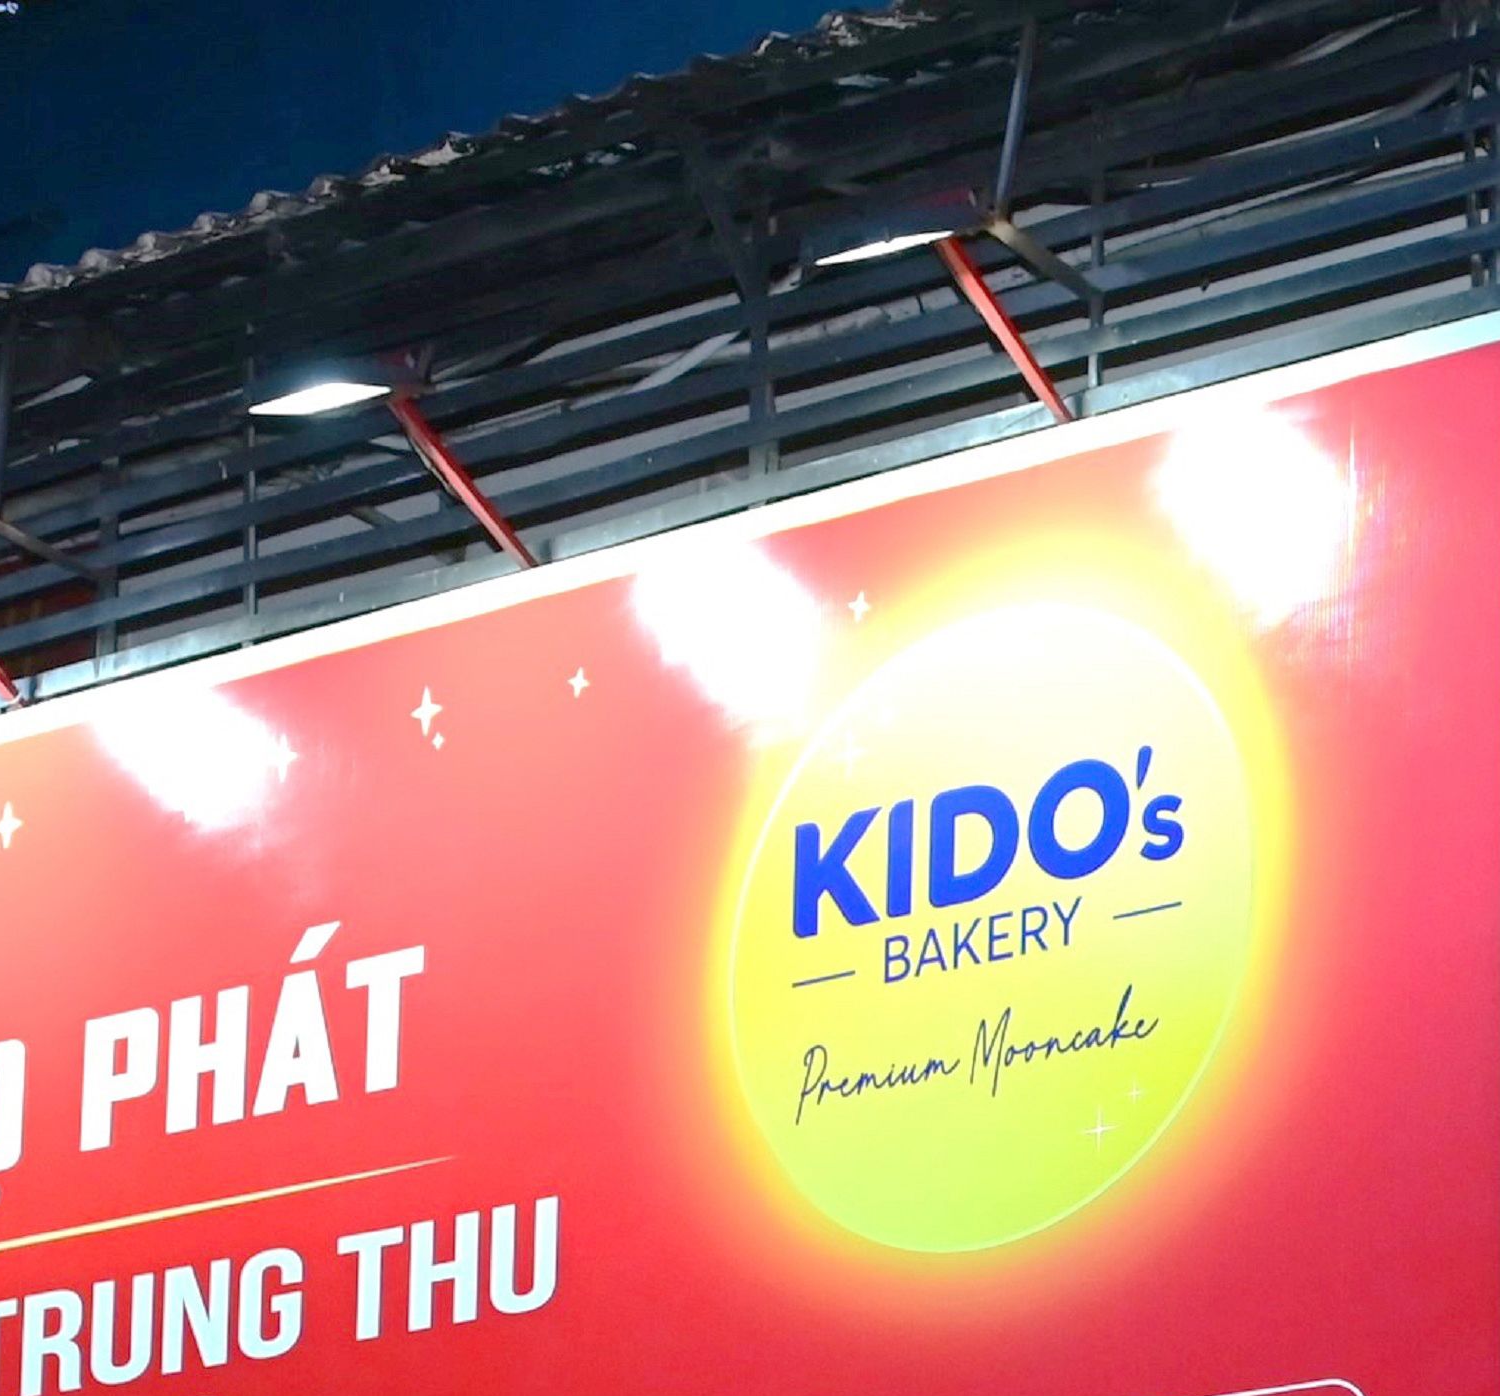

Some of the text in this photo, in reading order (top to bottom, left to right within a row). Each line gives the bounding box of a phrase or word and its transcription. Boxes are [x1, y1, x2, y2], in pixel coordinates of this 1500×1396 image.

[793, 745, 1185, 939] KIDO's
[883, 897, 1083, 985] BAKERY
[79, 921, 425, 1152] PHÁT
[337, 1195, 560, 1341] THU
